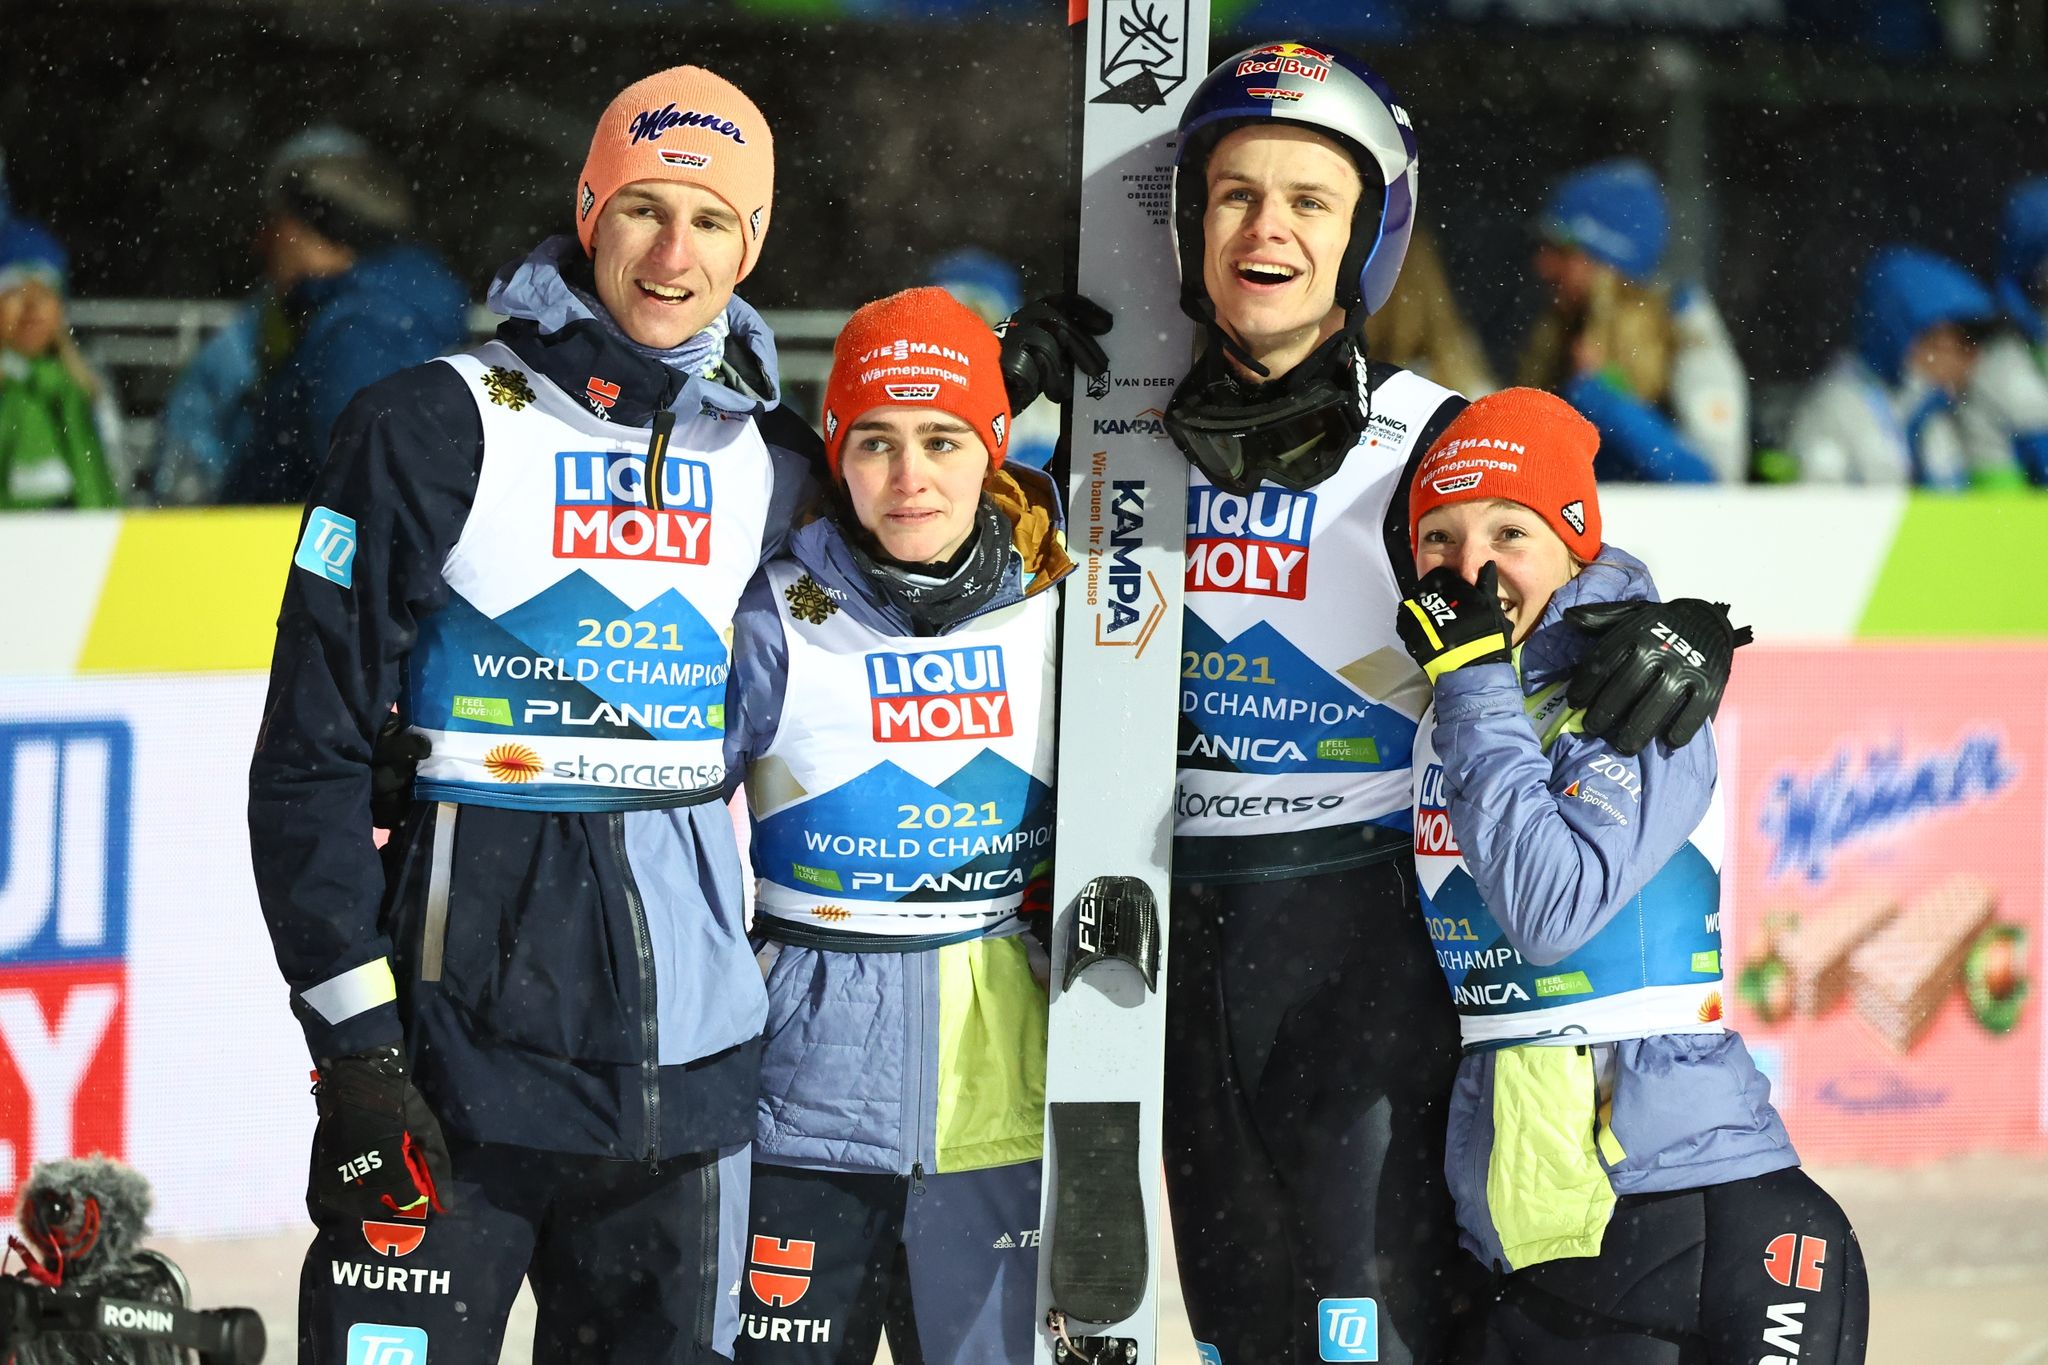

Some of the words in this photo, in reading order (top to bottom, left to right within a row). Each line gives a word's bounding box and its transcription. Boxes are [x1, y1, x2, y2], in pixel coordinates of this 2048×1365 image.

[1236, 58, 1282, 77] Red
[1283, 58, 1329, 84] Bull
[629, 102, 745, 145] Manner
[861, 366, 967, 386] Wärmepumpen
[1115, 378, 1141, 387] VAN
[1143, 378, 1175, 387] DEER
[1093, 419, 1164, 435] KAMPA
[1364, 427, 1401, 444] PIONSHIPS
[1369, 411, 1407, 433] LANICA
[1092, 451, 1107, 476] Wir
[1420, 458, 1518, 489] Wärmepumpen
[563, 456, 708, 509] LIQUI
[1090, 480, 1106, 522] bauen
[313, 518, 355, 577] TQ
[561, 510, 710, 560] MOLY
[1089, 526, 1105, 545] Ihr
[1107, 480, 1146, 634] KAMPA
[1087, 548, 1104, 606] Zuhause
[1421, 592, 1457, 627] SEIZ
[576, 617, 684, 652] 2021
[1650, 621, 1706, 668] SEIZ
[473, 653, 599, 682] WORLD
[873, 650, 1001, 695] LIQUI
[1182, 650, 1276, 684] 2021
[462, 698, 484, 707] FEEL
[524, 699, 705, 729] PLANICA
[878, 696, 1006, 739] MOLY
[1177, 733, 1309, 763] ANICA
[1326, 740, 1350, 748] FEEL
[897, 801, 1003, 829] 2021
[1175, 784, 1345, 818] toraenso
[1579, 790, 1628, 826] Sporthilfe
[804, 830, 920, 858] WORLD
[1417, 813, 1458, 852] MOL
[852, 867, 1024, 892] PLANICA
[1445, 948, 1522, 970] CHAMPI
[1454, 982, 1531, 1006] ANICA
[1543, 977, 1563, 986] FEEL
[337, 1150, 383, 1183] SEIZ
[332, 1260, 451, 1295] WÜRTH
[104, 1304, 174, 1332] RONIN
[1326, 1308, 1368, 1354] TQ
